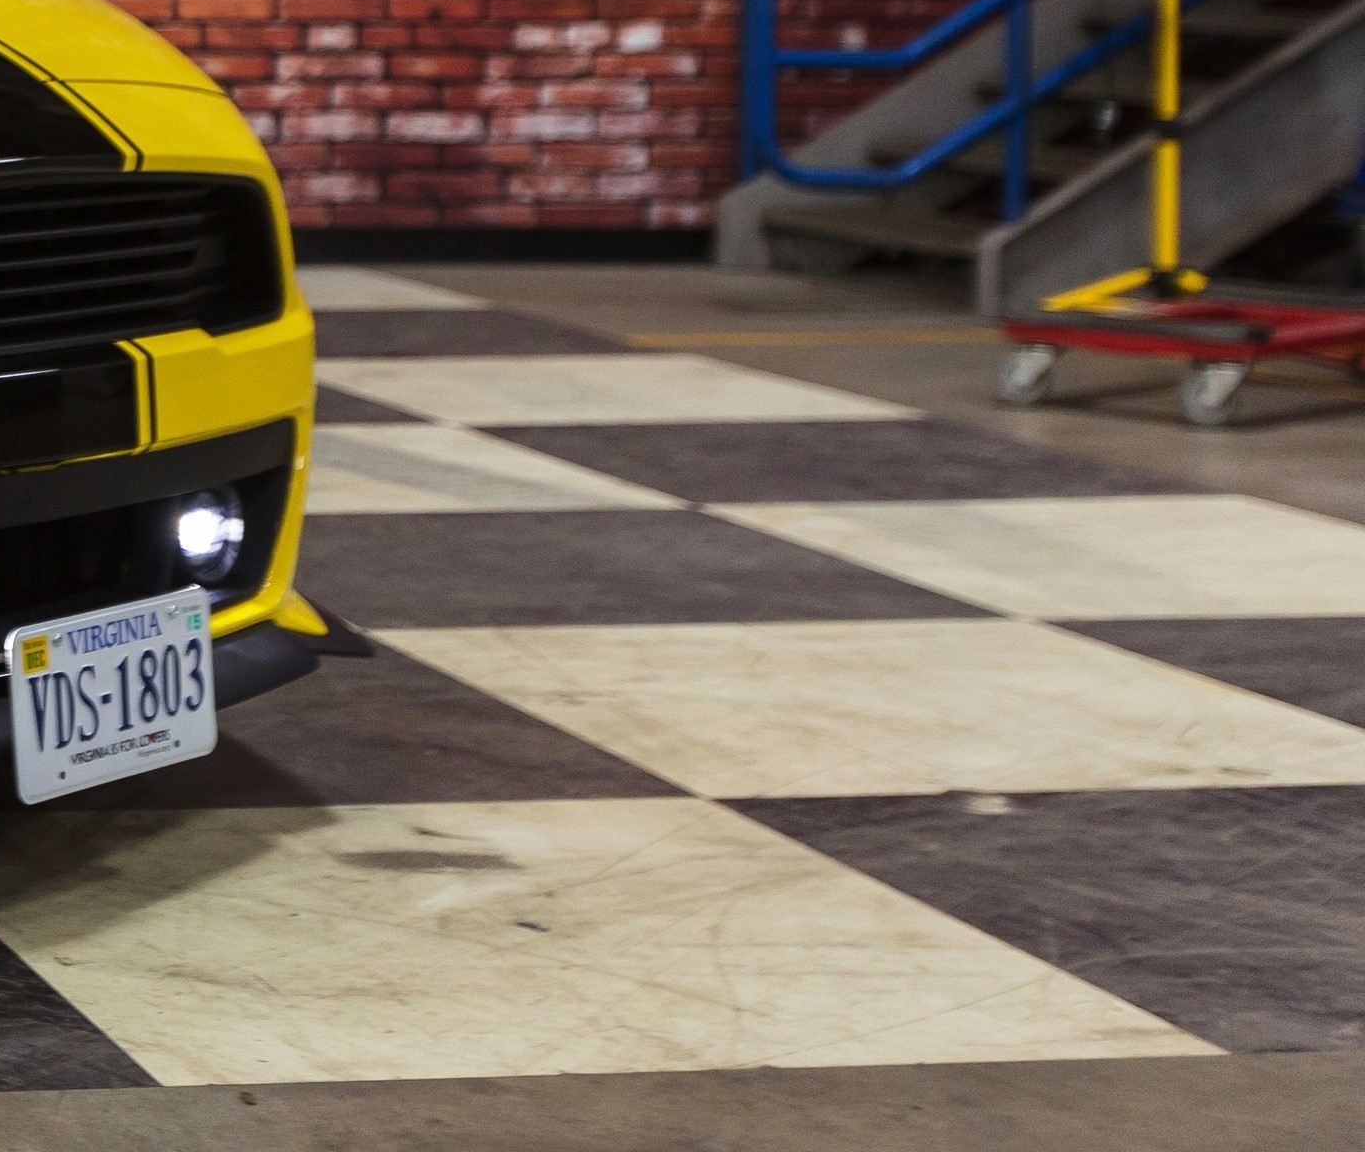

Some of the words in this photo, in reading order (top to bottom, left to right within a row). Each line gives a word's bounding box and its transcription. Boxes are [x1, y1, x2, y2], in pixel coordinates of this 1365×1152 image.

[67, 610, 163, 656] VIRGINIA
[27, 637, 205, 753] VDS-1803
[70, 747, 110, 765] VIRGINIA
